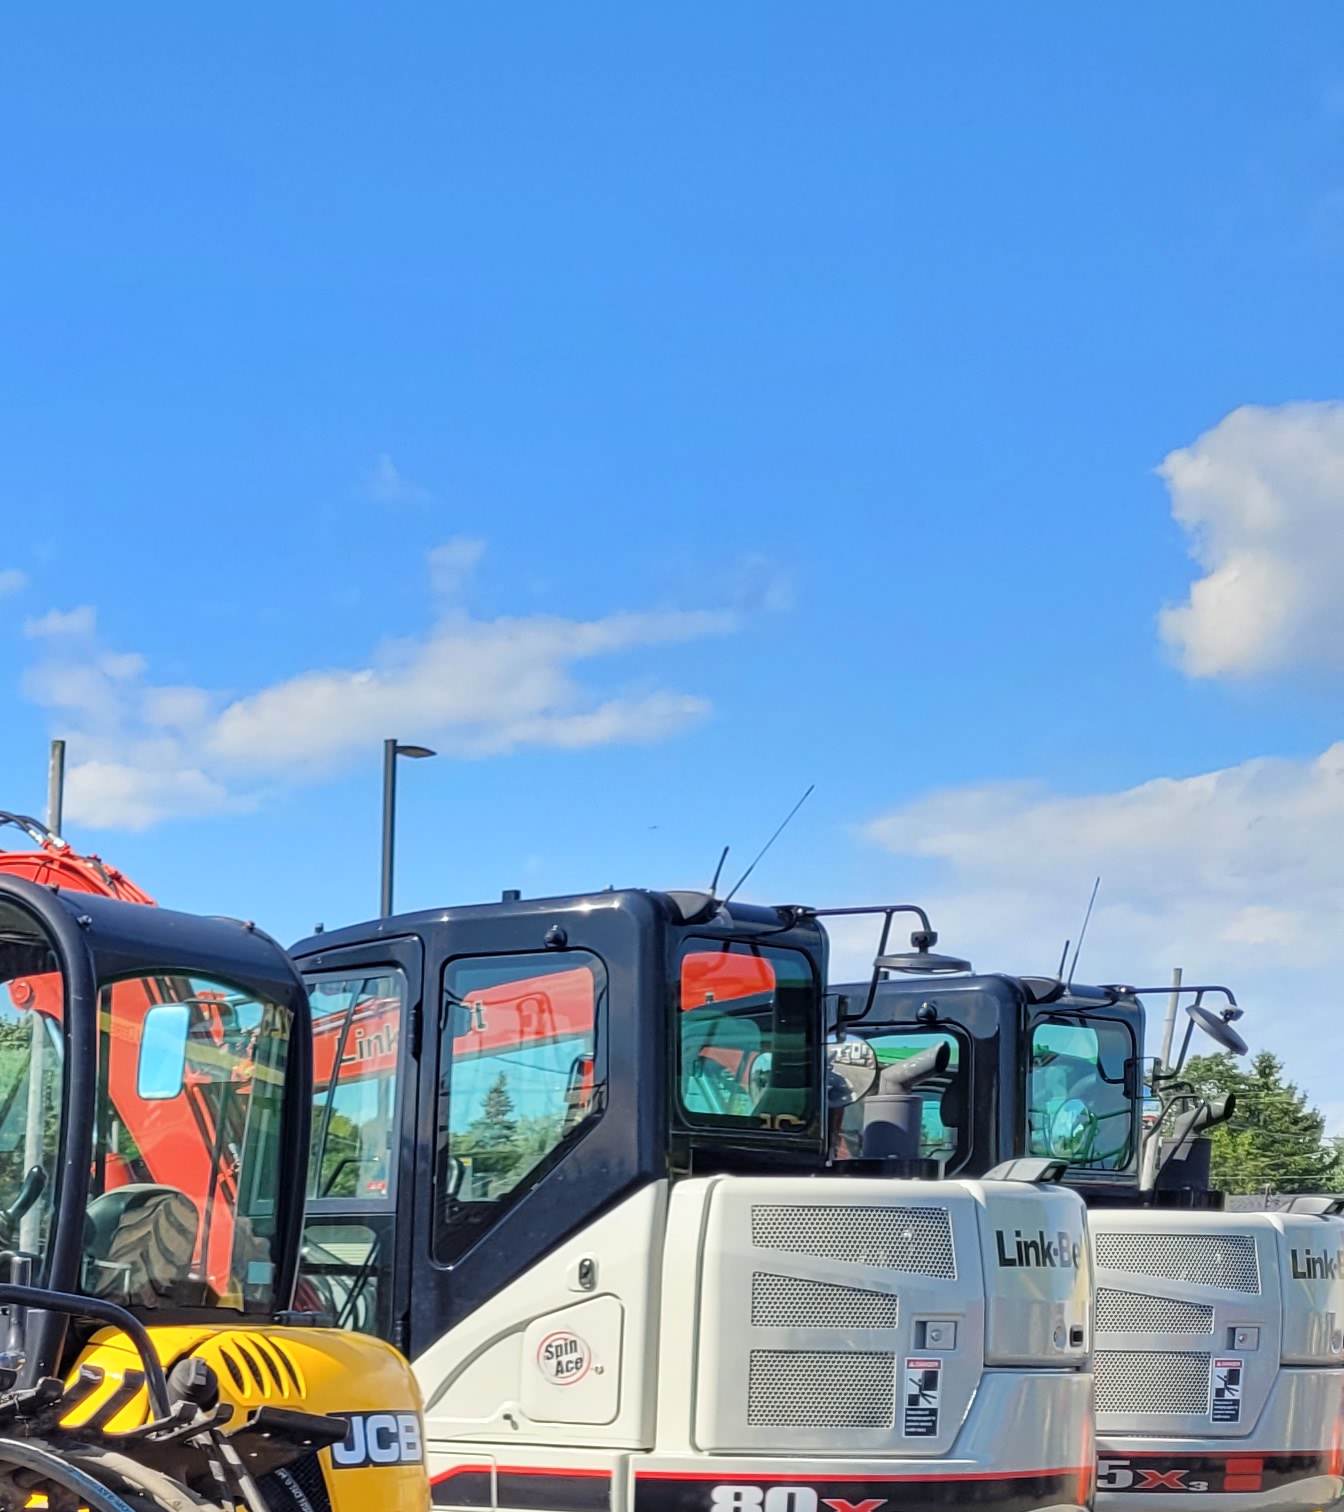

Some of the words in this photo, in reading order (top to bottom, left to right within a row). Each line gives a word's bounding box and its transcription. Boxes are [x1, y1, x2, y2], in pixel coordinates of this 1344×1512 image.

[544, 1338, 578, 1361] Spin
[555, 1356, 584, 1377] Ace
[332, 1414, 423, 1465] JCB
